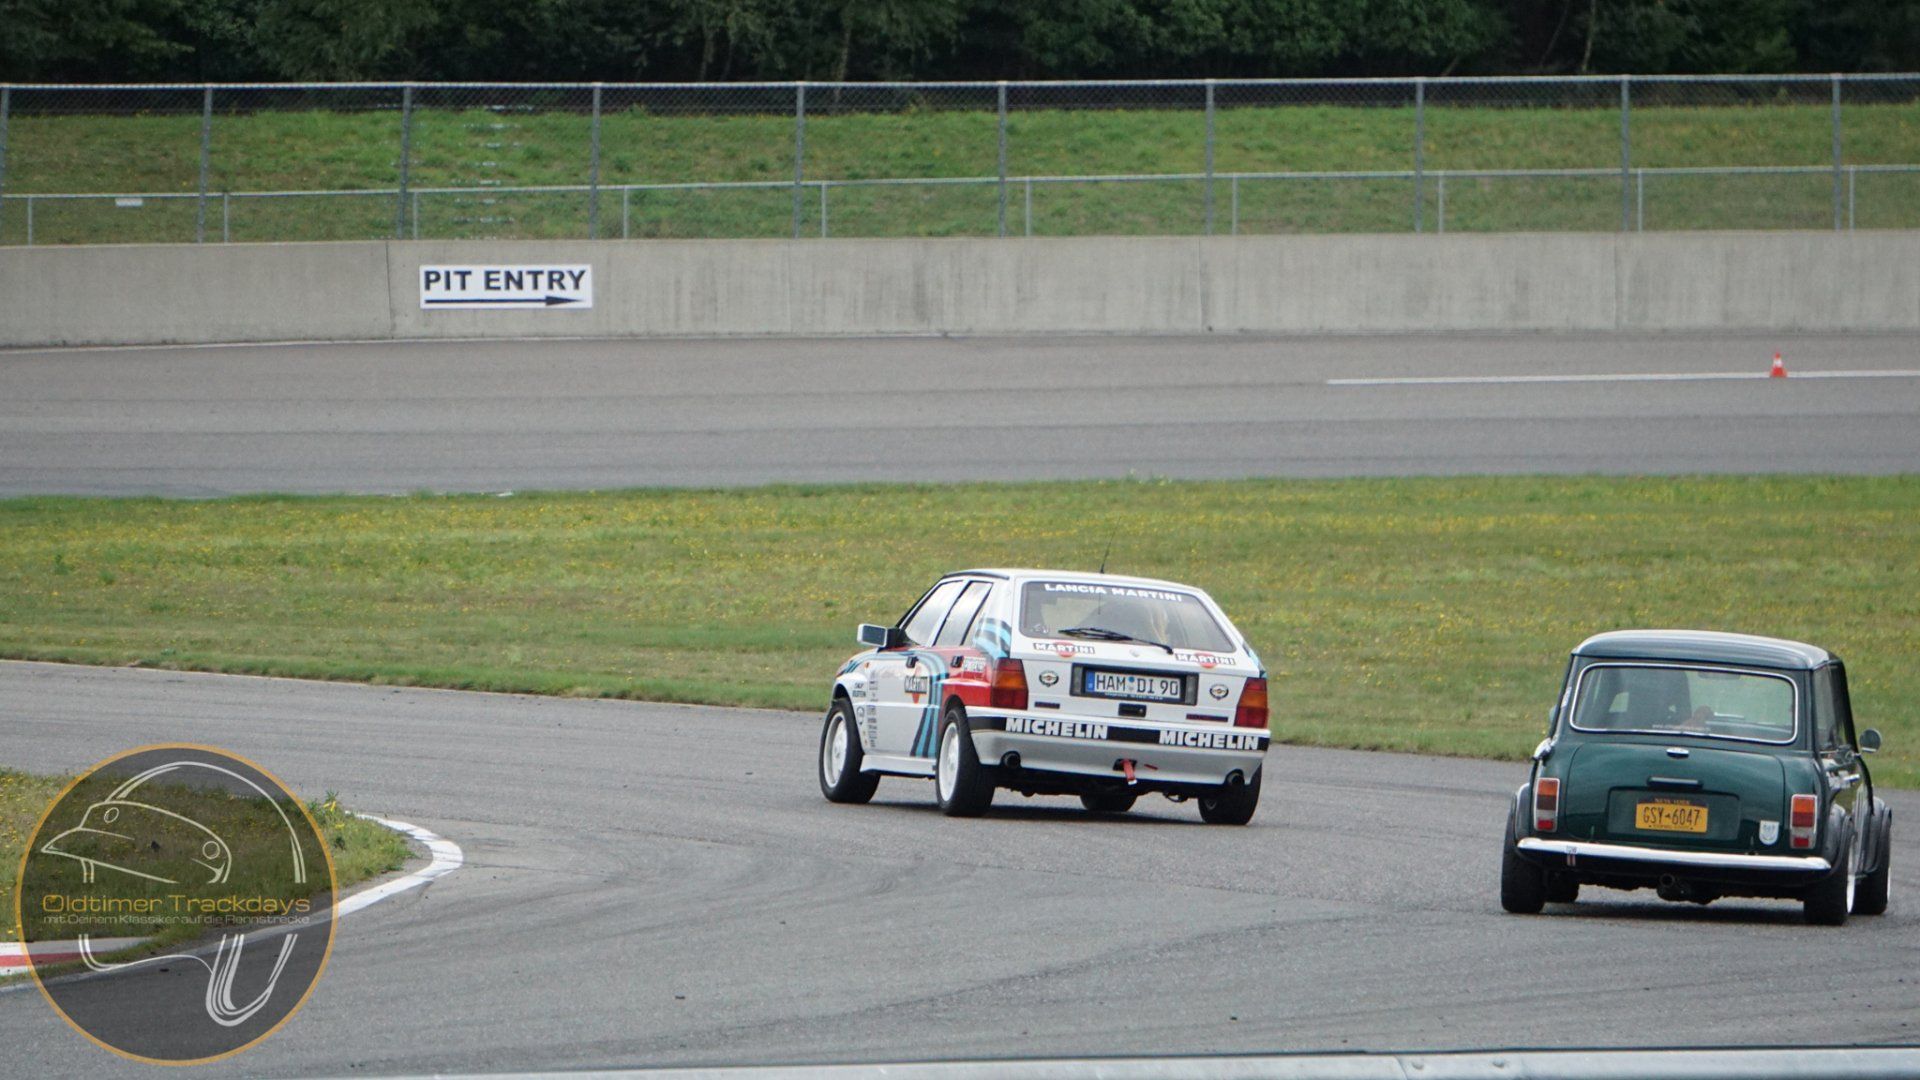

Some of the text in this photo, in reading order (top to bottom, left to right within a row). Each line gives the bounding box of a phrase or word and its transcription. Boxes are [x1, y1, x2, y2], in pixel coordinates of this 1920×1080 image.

[424, 270, 586, 291] PIT ENTRY
[1044, 583, 1182, 602] LANCIA MARTINI
[1034, 642, 1095, 654] MARTINI
[1176, 653, 1235, 665] MARTINI
[1096, 674, 1126, 691] HAM
[1137, 678, 1154, 694] DI
[1160, 680, 1178, 696] 90
[1005, 718, 1108, 740] MICHELIN
[1159, 730, 1259, 750] MICHELIN
